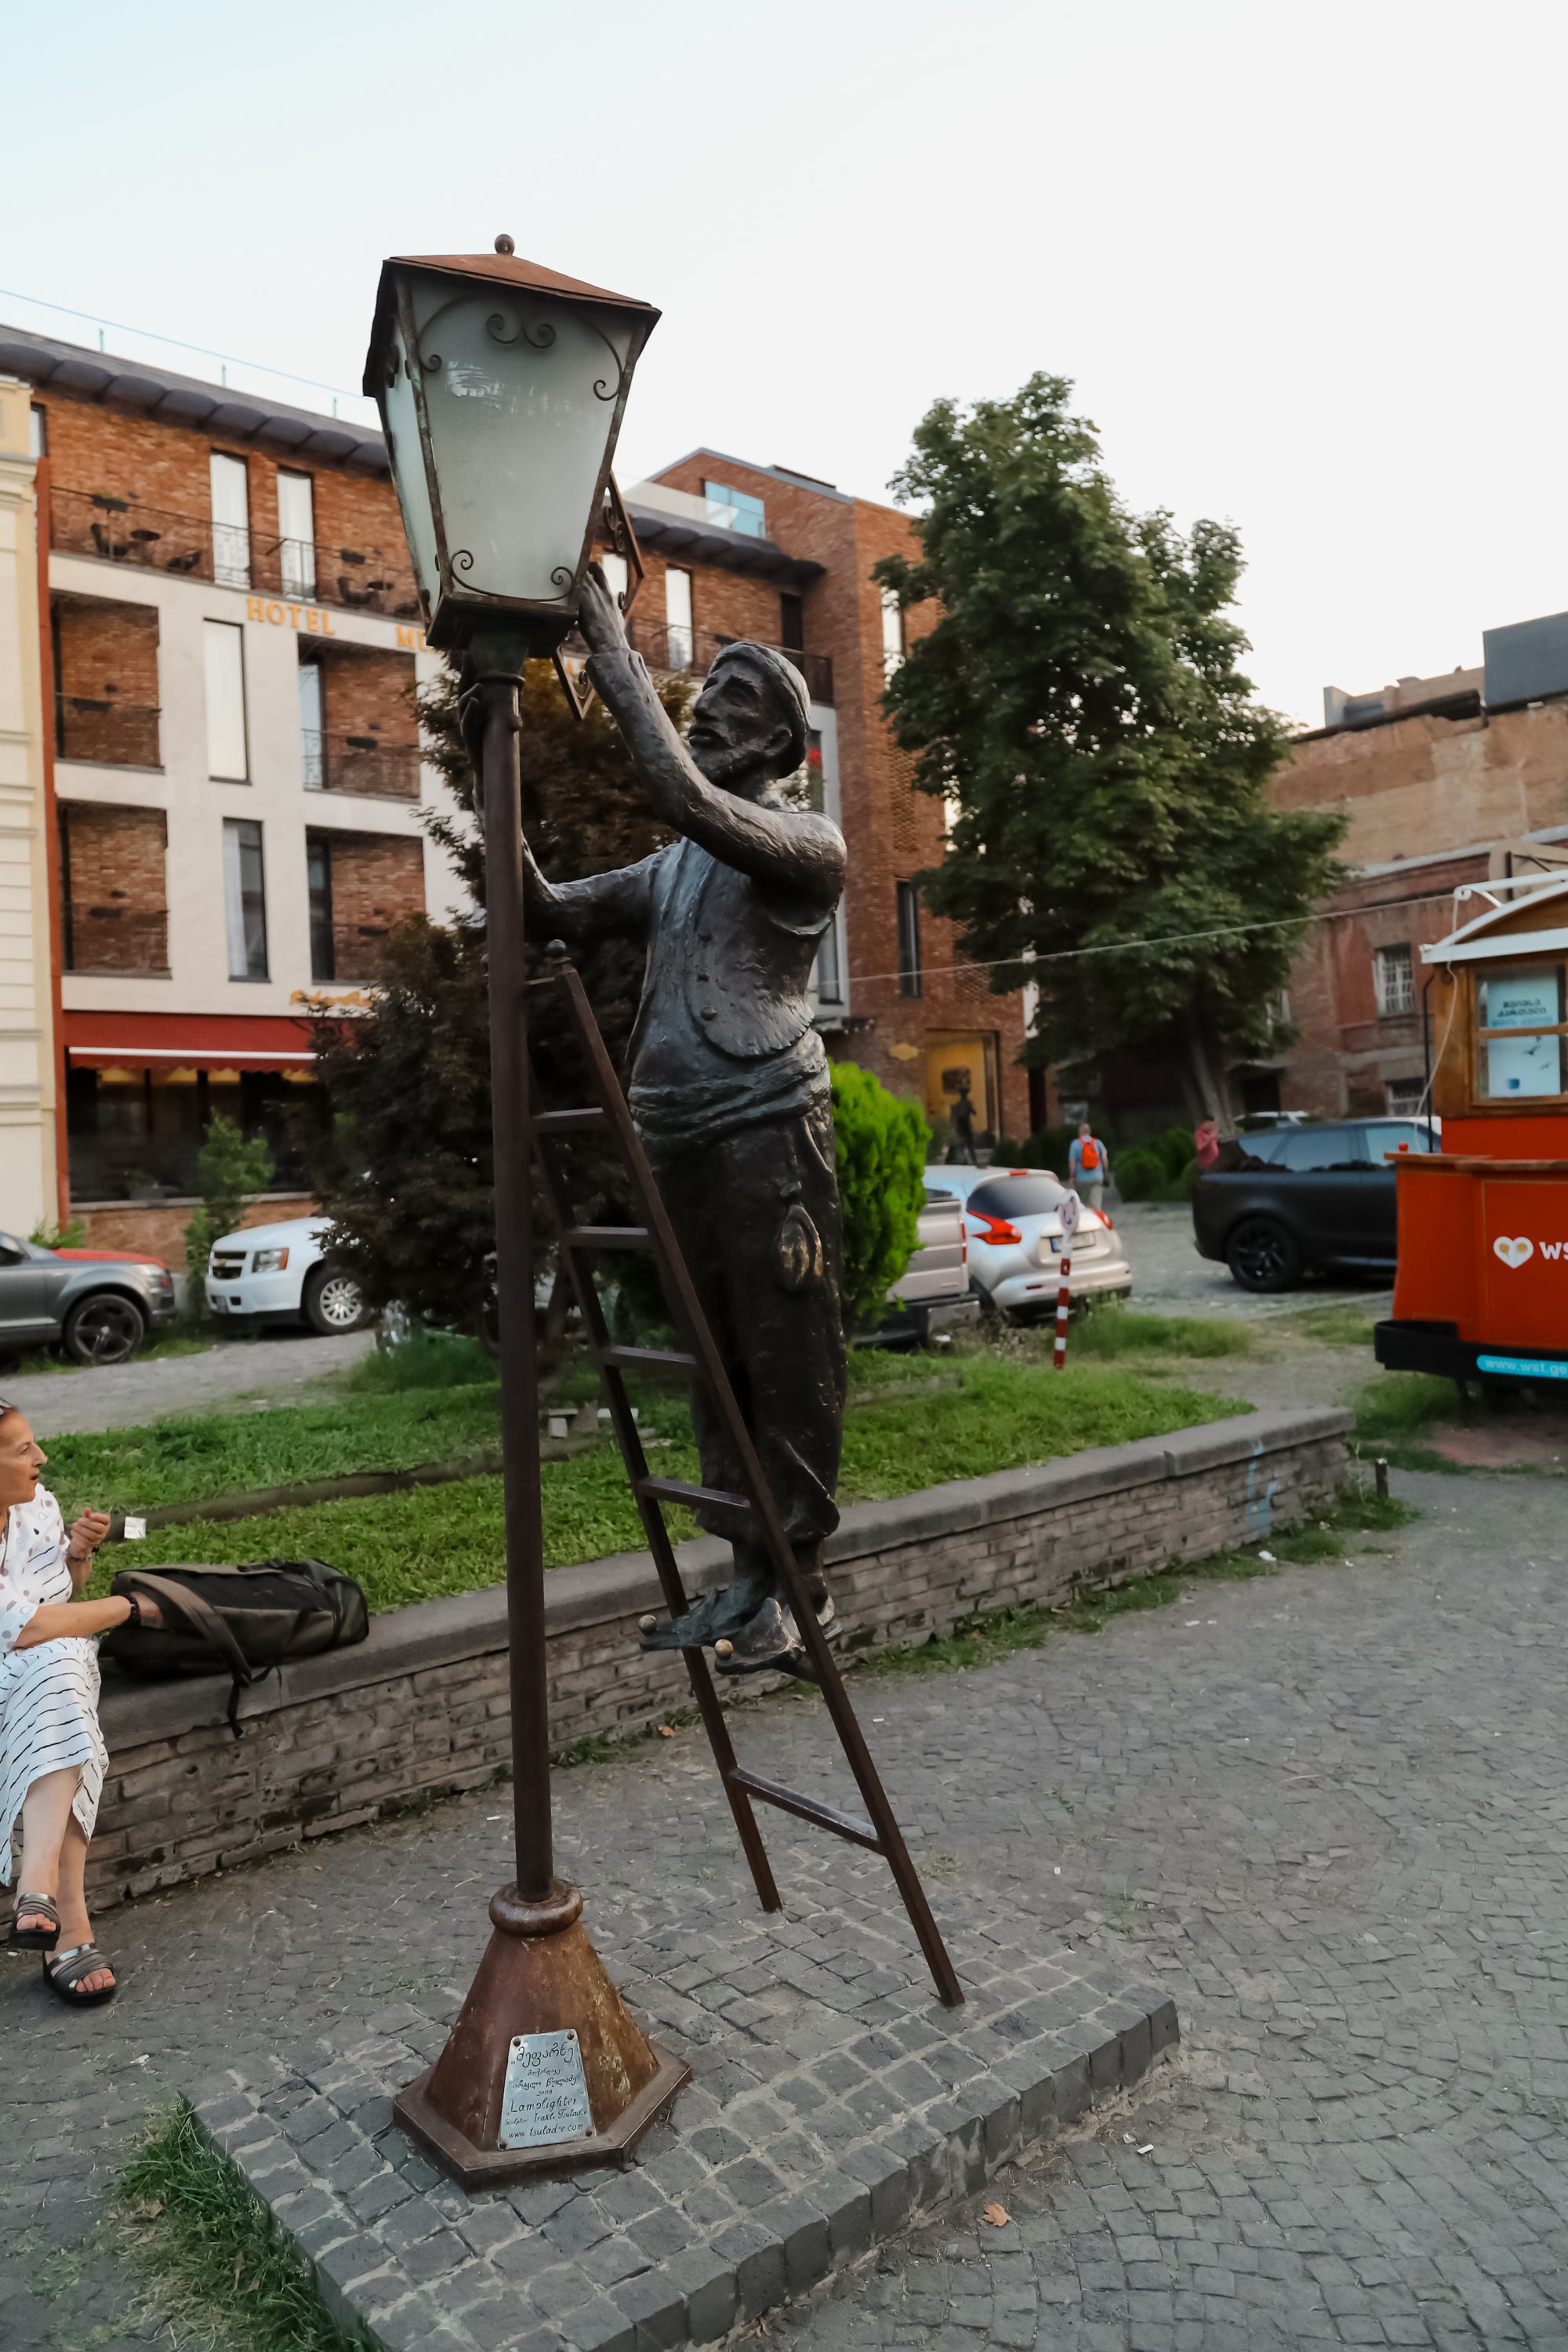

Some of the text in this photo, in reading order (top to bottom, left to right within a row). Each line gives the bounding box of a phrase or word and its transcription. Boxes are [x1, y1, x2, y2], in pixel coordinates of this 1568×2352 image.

[247, 596, 336, 635] HOTEL
[1485, 1359, 1568, 1377] www.wst.ge
[513, 2079, 541, 2091] ირაკლი
[533, 2112, 555, 2122] Irakli
